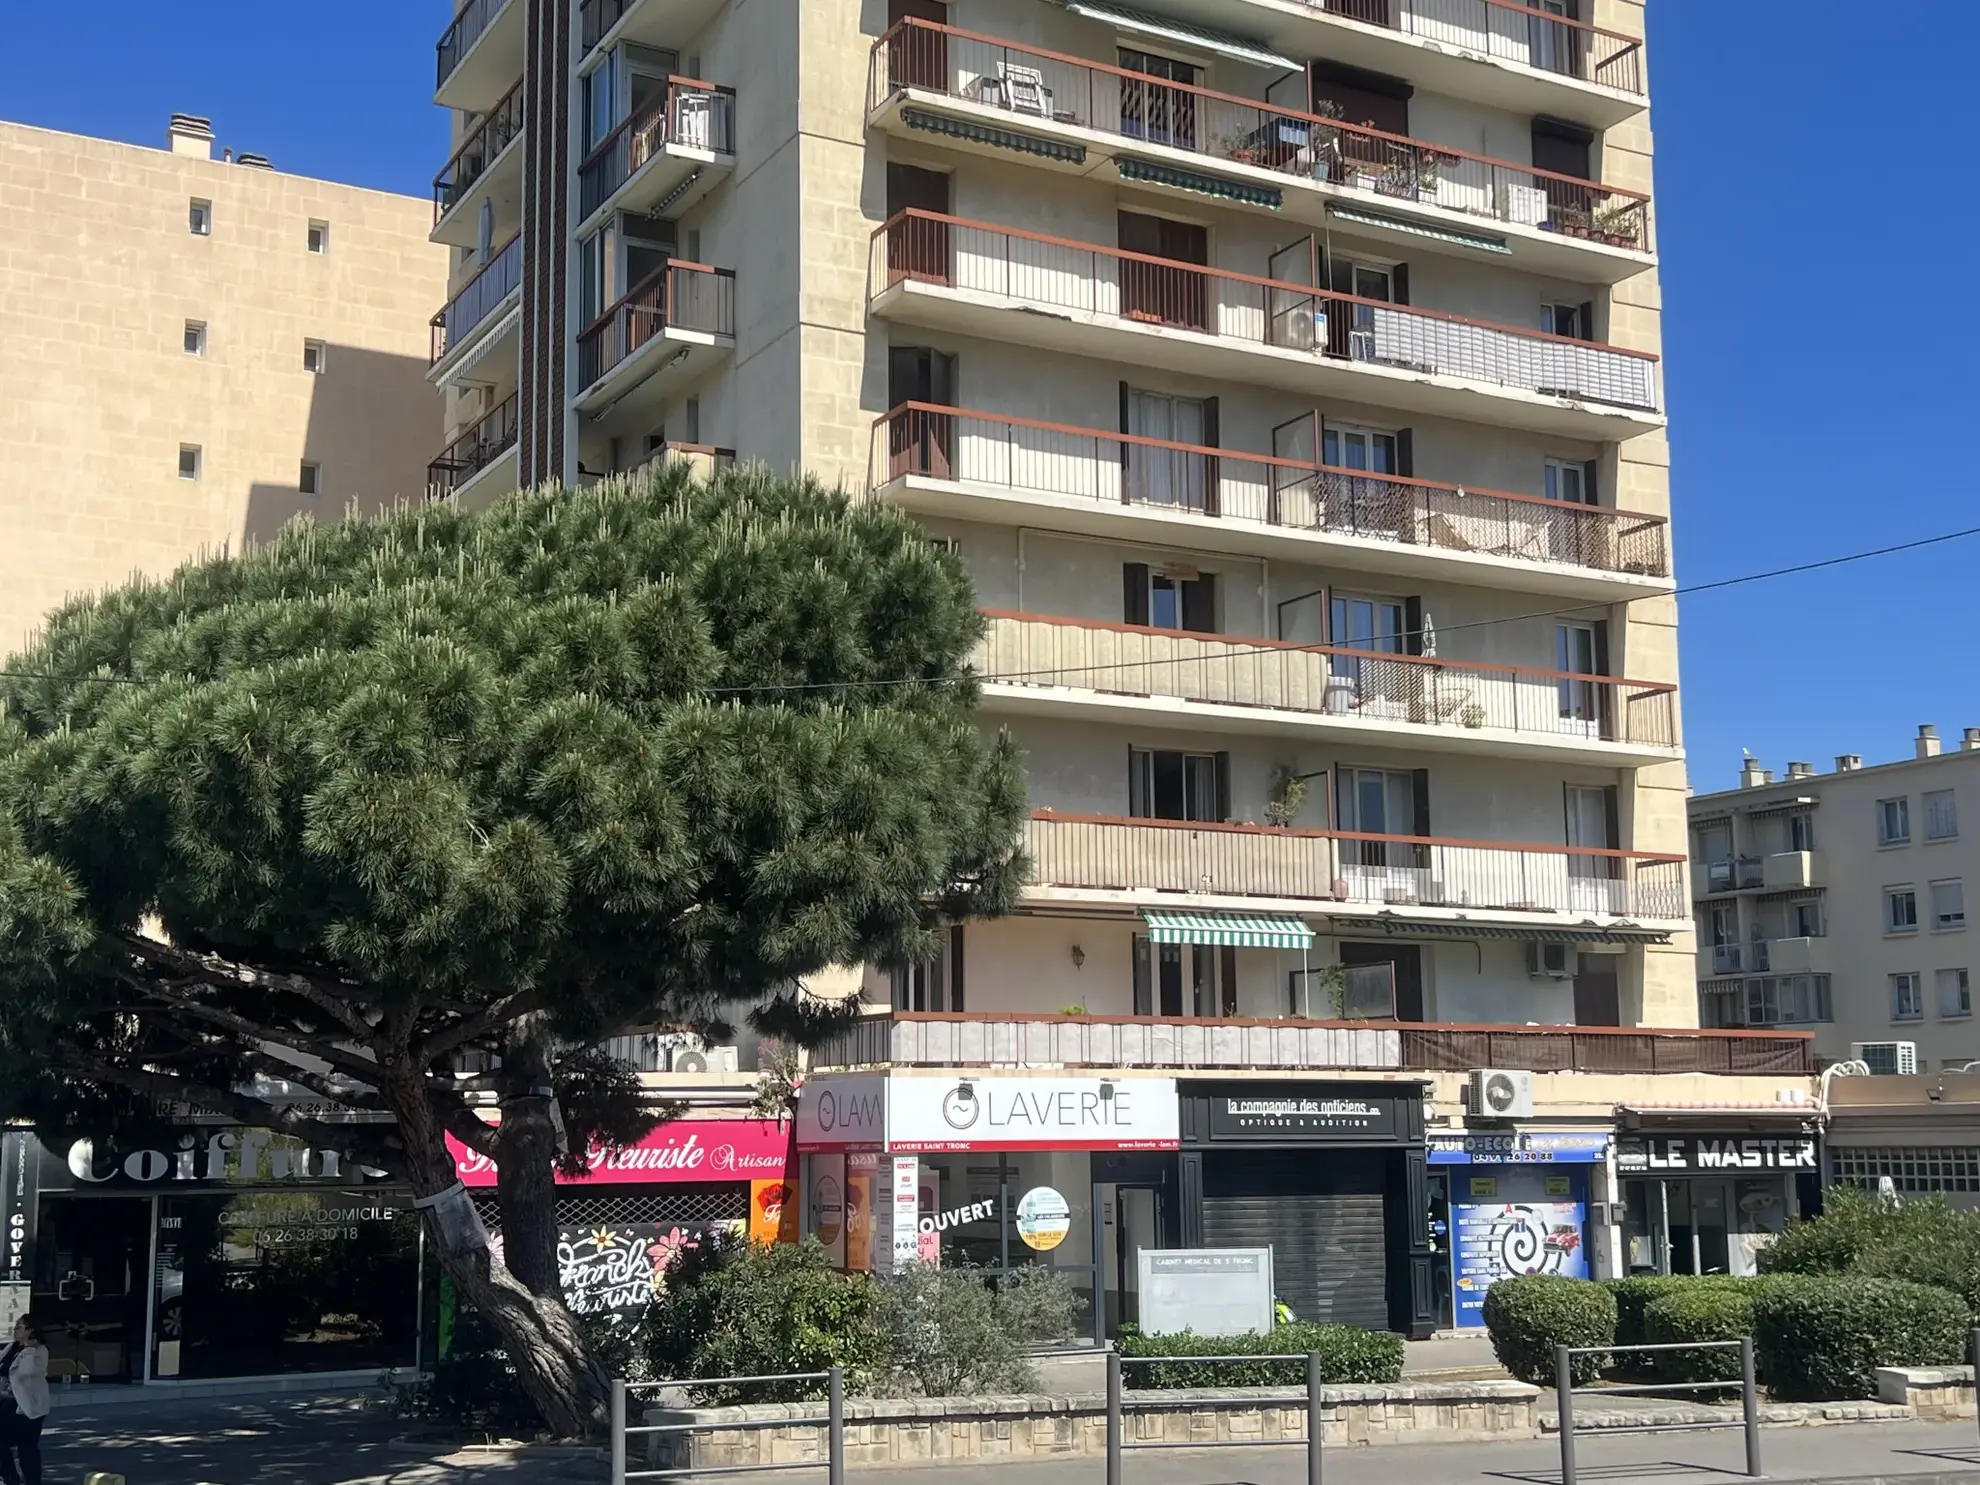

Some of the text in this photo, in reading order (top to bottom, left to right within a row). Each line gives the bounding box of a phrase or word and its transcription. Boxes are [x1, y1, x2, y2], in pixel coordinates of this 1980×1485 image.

[1228, 1099, 1366, 1117] la compagnie des opticiens
[1313, 1119, 1368, 1127] AUDITION
[892, 1143, 922, 1151] LAVERIE
[924, 1142, 944, 1150] SAINT
[947, 1142, 971, 1150] TRONC
[1648, 1140, 1817, 1168] LE MASTER
[67, 1132, 390, 1182] Coiffur
[709, 1143, 787, 1172] Artisan
[1507, 1153, 1520, 1161] 26
[1524, 1153, 1537, 1161] 20
[317, 1207, 393, 1221] DOMICILE
[919, 1198, 994, 1234] OUVERT
[275, 1229, 292, 1242] 26
[297, 1229, 315, 1241] 38
[343, 1227, 359, 1240] 18
